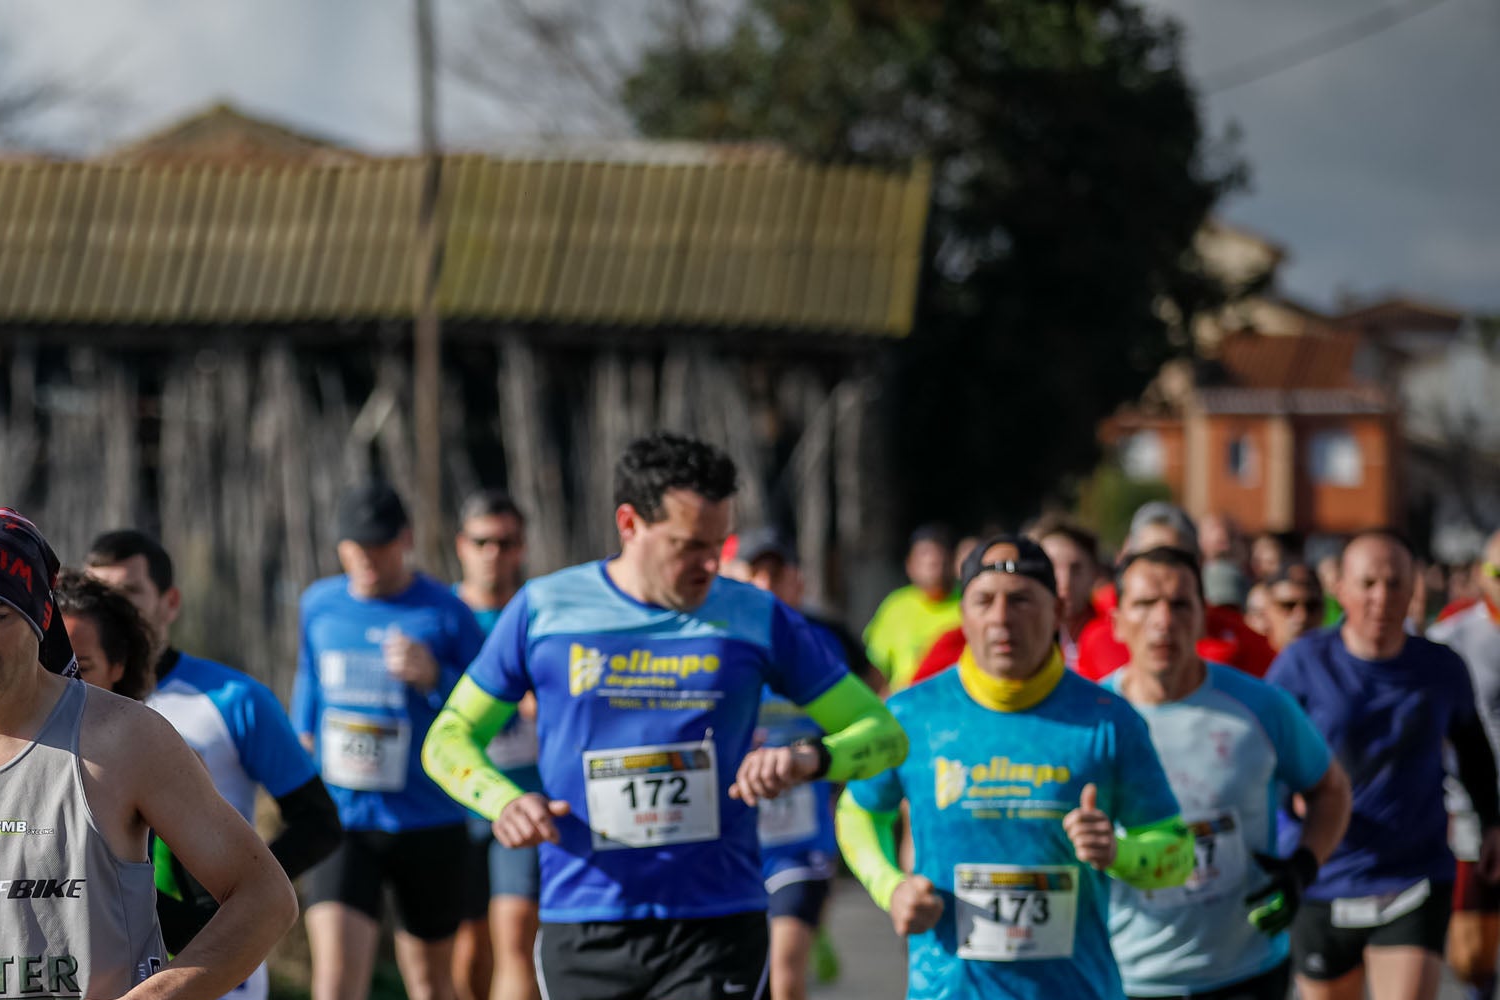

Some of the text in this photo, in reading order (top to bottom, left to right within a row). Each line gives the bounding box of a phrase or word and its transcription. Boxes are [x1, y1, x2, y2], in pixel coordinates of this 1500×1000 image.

[610, 650, 720, 678] olimpo
[971, 756, 1071, 787] olimpo
[622, 776, 690, 809] 172
[988, 897, 1050, 925] 173
